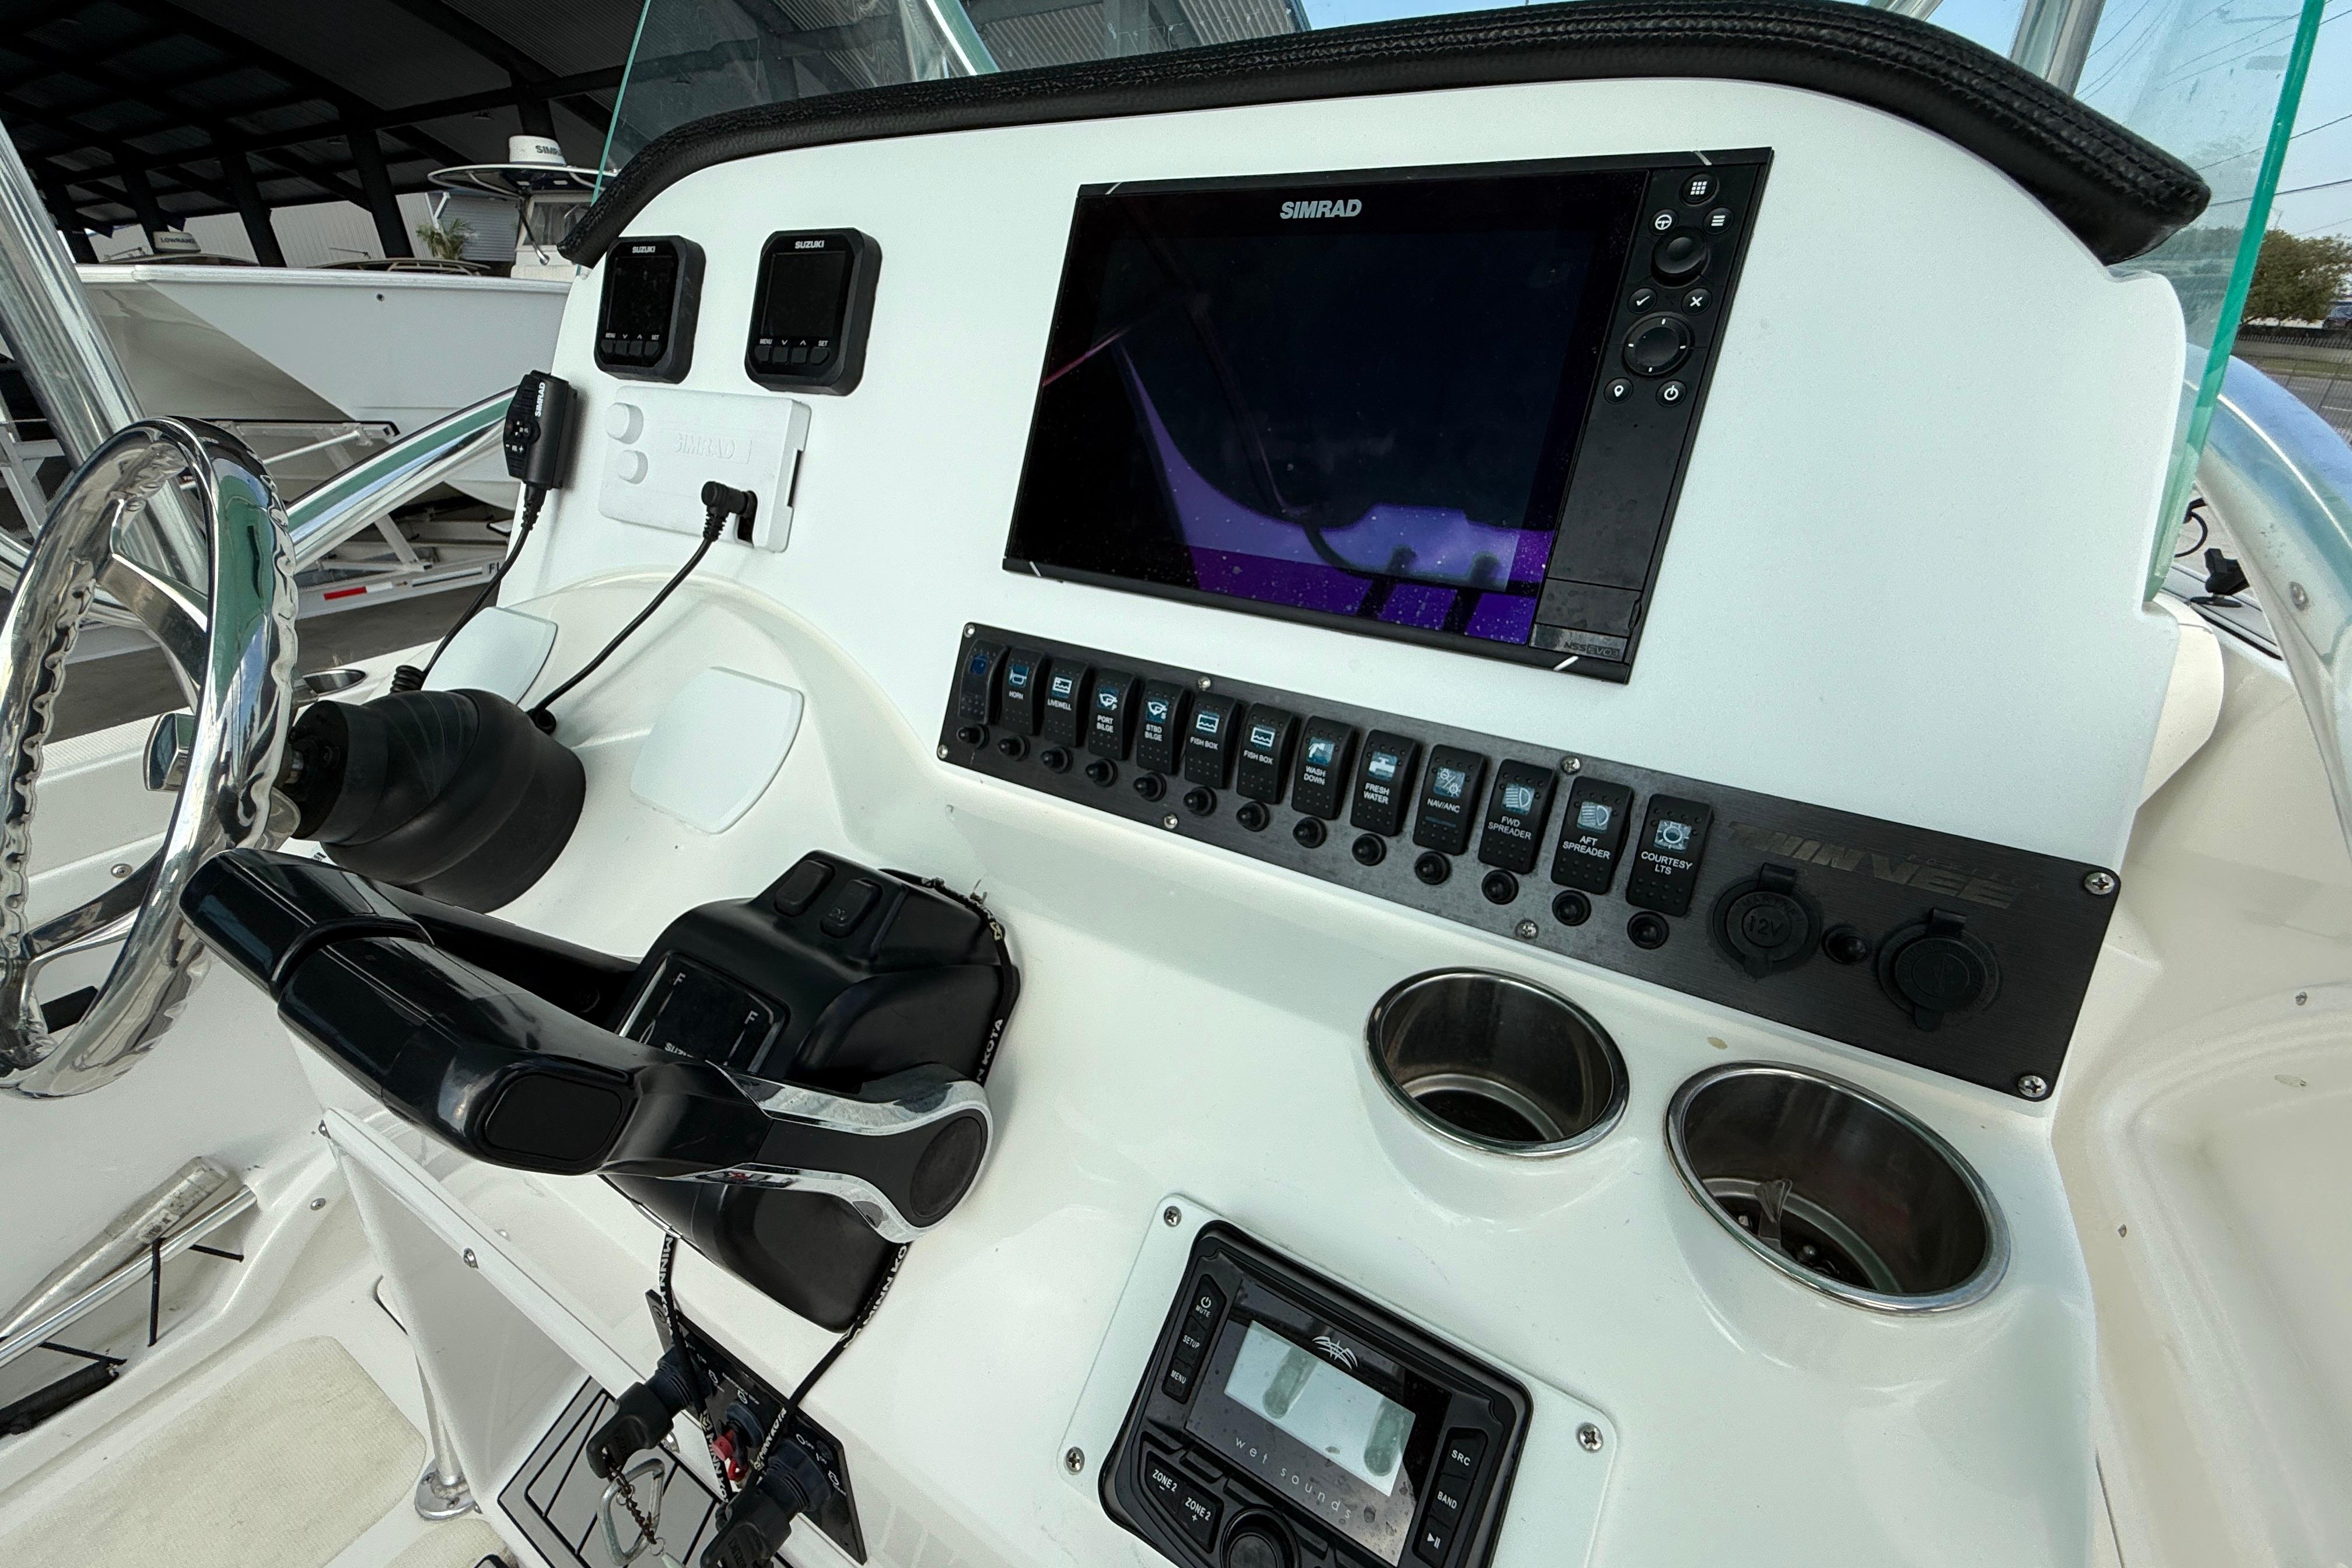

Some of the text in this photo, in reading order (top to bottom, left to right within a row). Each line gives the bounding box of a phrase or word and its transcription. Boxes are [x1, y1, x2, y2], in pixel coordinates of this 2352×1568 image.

[1279, 199, 1363, 219] SIMRAD
[794, 240, 825, 249] SUZUKI
[534, 382, 546, 418] SIMRAD
[1009, 691, 1024, 700] HORN
[1047, 699, 1072, 711] LIVEWELL
[1097, 715, 1114, 724] PORT
[1096, 723, 1114, 733] BILGE
[1146, 724, 1162, 733] STBD
[1144, 732, 1163, 741] BILGE
[1190, 736, 1219, 750] FISH BOX
[1244, 750, 1273, 765] FISH BOX
[1306, 765, 1326, 777] WASH
[1303, 773, 1325, 785] DOWN
[1365, 783, 1390, 796] FRESH
[1363, 790, 1389, 804] WATER
[1427, 798, 1461, 813] NAV/ANC
[1502, 816, 1521, 827] FWD
[1488, 821, 1532, 840] SPREADER
[1579, 835, 1598, 846] AFT
[1562, 841, 1611, 859] SPREADER
[1641, 851, 1693, 871] COURTESY
[1728, 821, 2023, 909] TWIN VEE
[1654, 864, 1672, 875] LTS
[1749, 915, 1784, 937] 12V
[673, 972, 687, 986] F
[744, 1010, 758, 1024] F
[982, 1019, 1003, 1066] KOTA
[659, 1237, 674, 1287] MINN
[890, 1245, 907, 1273] KO
[1195, 1305, 1211, 1318] MUTE
[1182, 1335, 1200, 1349] SETUP
[1170, 1370, 1187, 1384] MENU
[1451, 1450, 1471, 1466] SRC
[1152, 1469, 1177, 1492] ZONE 2
[1236, 1437, 1352, 1519] wet sounds
[1437, 1491, 1457, 1509] BAND
[1185, 1497, 1211, 1521] ZONE 2
